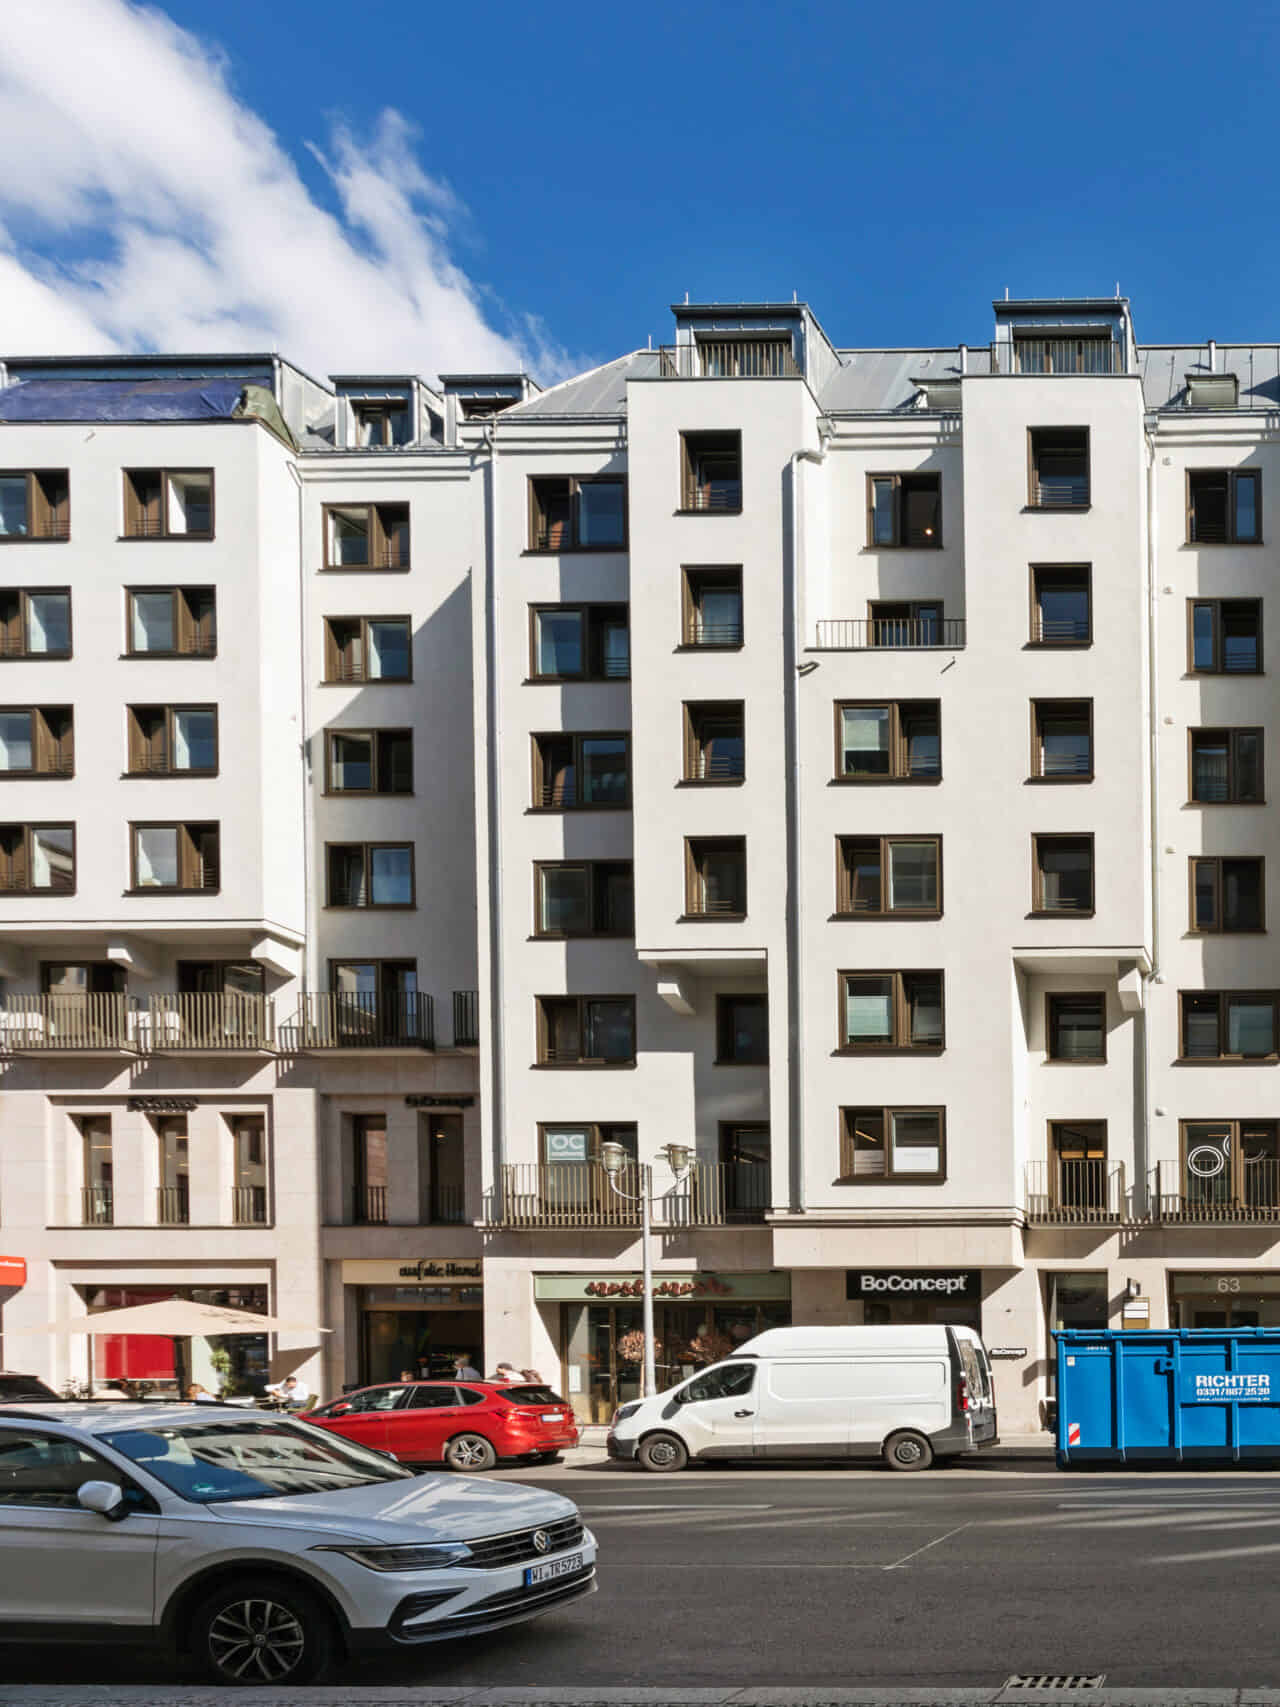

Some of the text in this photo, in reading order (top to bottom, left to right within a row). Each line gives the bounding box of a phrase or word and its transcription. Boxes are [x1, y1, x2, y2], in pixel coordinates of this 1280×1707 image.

[860, 1275, 967, 1294] BoConcept
[1217, 1277, 1240, 1293] 63
[1195, 1374, 1270, 1387] RICHTER
